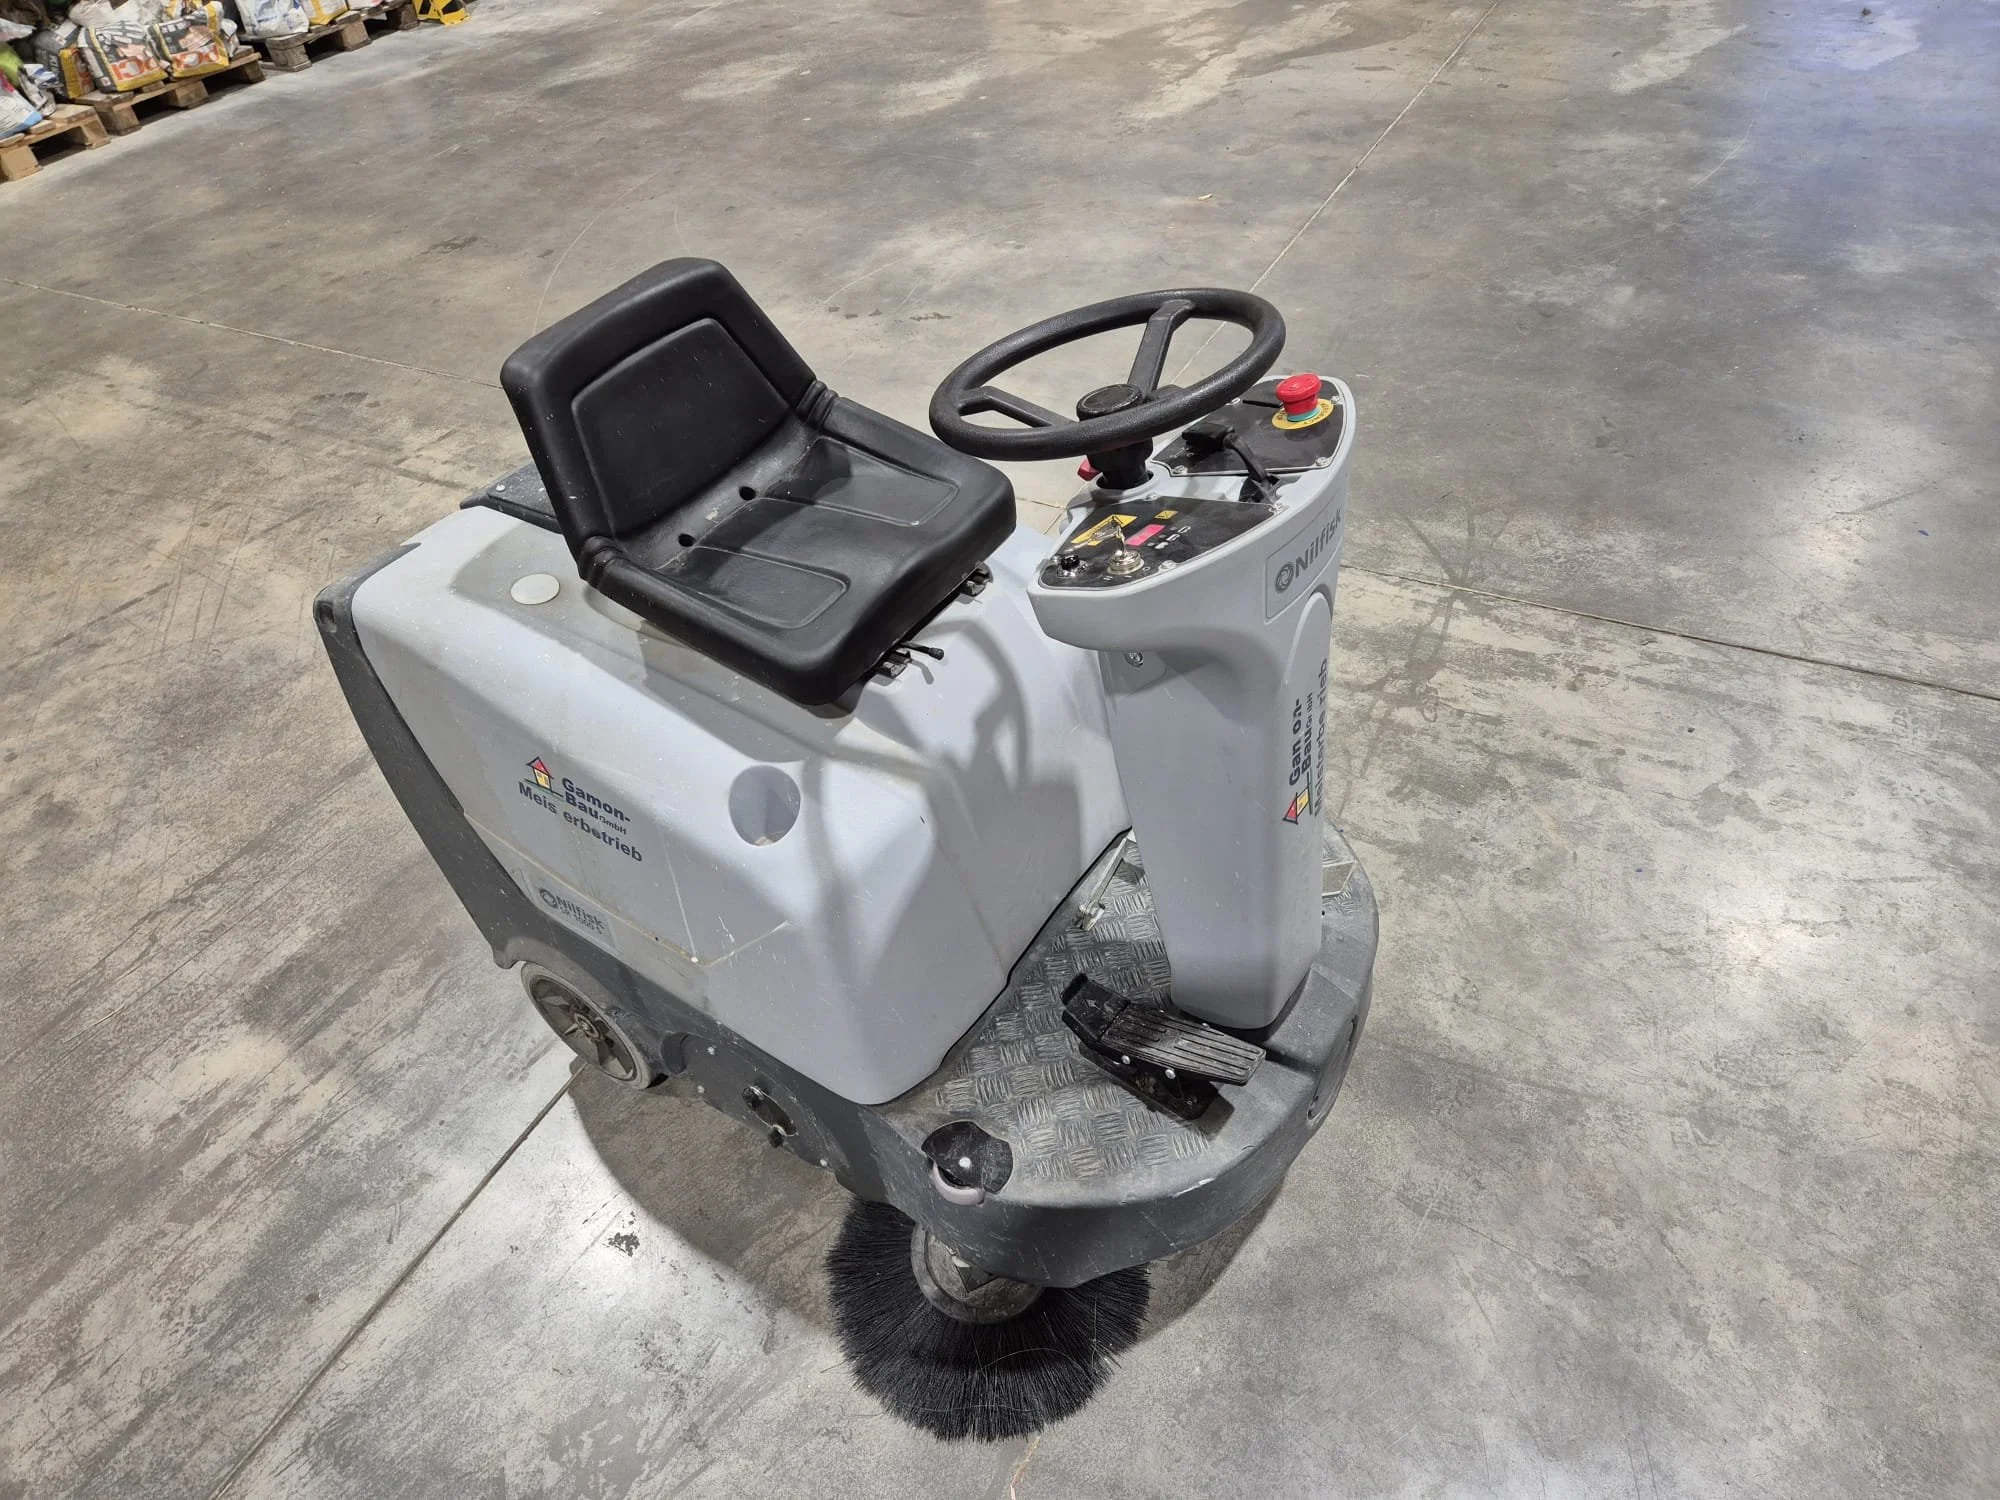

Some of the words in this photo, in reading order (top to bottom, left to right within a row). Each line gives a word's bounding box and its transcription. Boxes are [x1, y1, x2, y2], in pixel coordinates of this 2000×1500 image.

[1295, 505, 1342, 578] Nilfisk
[1301, 730, 1313, 775] Bau
[562, 777, 631, 822] Gamon-
